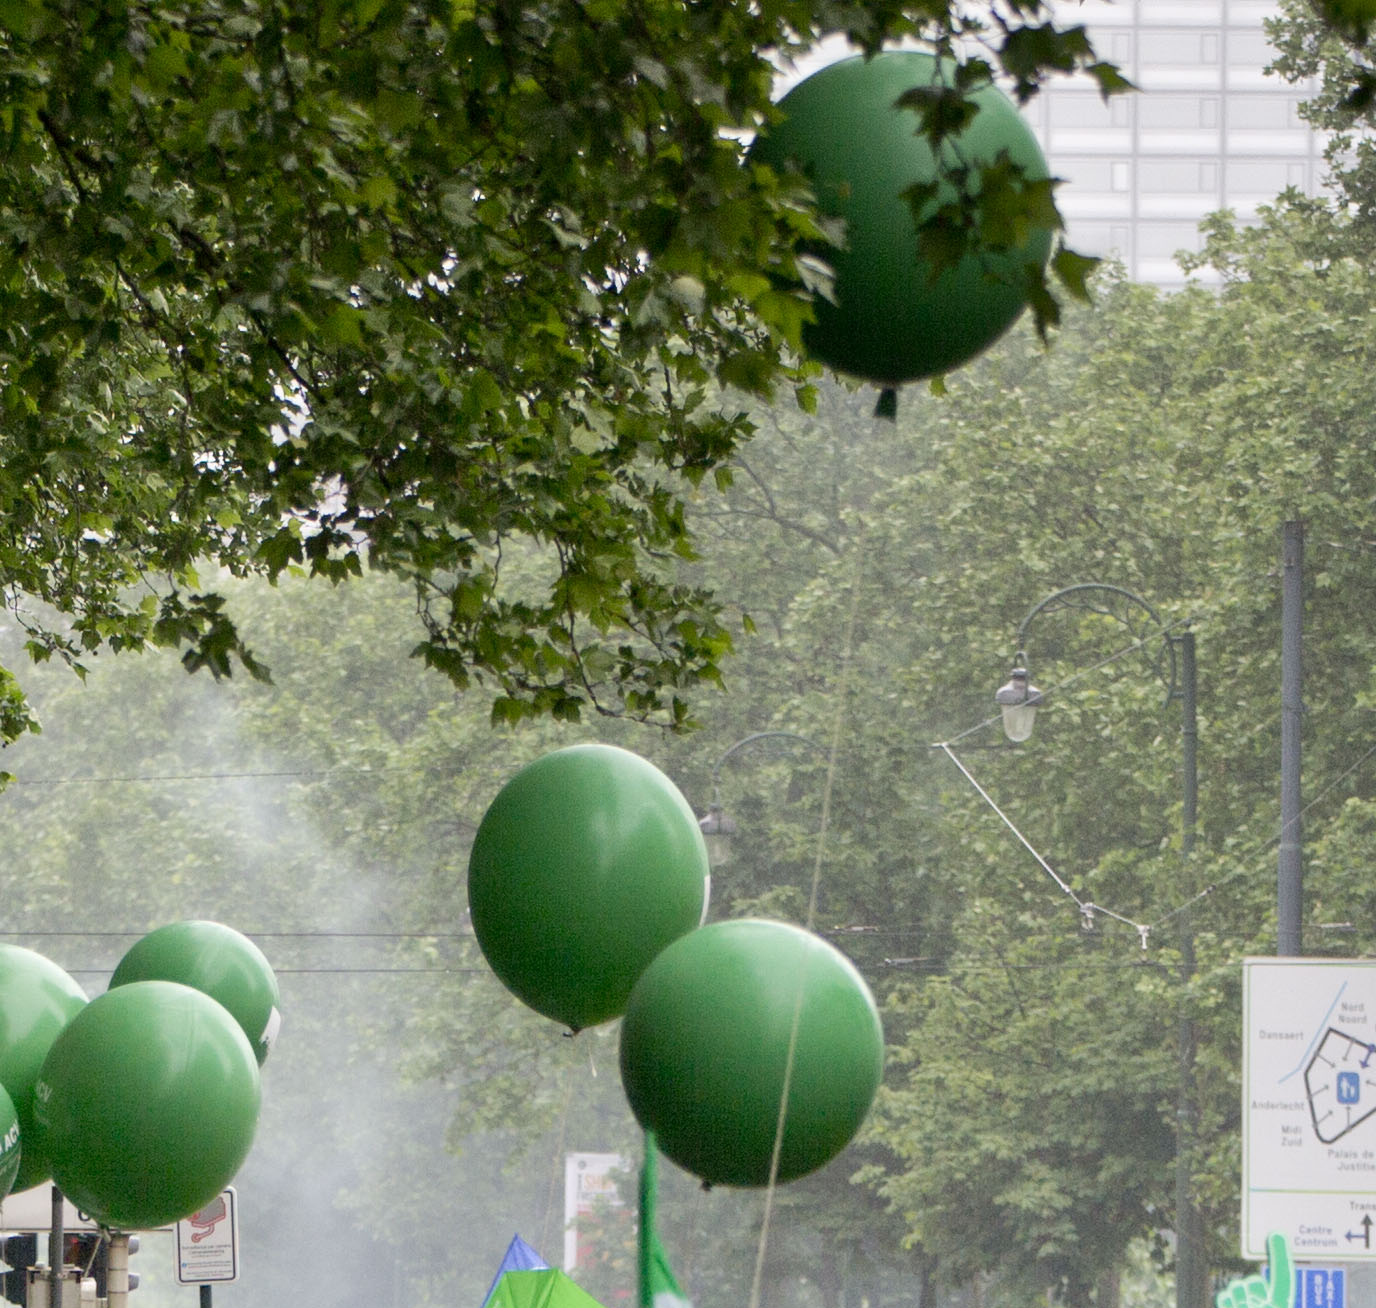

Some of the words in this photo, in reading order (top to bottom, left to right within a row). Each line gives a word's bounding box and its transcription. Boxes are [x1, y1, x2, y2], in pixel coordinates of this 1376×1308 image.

[1341, 1003, 1365, 1012] Nord
[1338, 1015, 1368, 1024] Noord
[1259, 1031, 1304, 1041] Dansaert
[1251, 1101, 1305, 1111] Anderlecht
[1281, 1125, 1303, 1135] Midi
[1281, 1137, 1303, 1147] Zuid
[1328, 1149, 1359, 1160] Palais
[1362, 1150, 1374, 1159] de
[1298, 1224, 1333, 1235] Centre
[1294, 1236, 1338, 1247] Centrum
[1314, 1273, 1324, 1307] BUS
